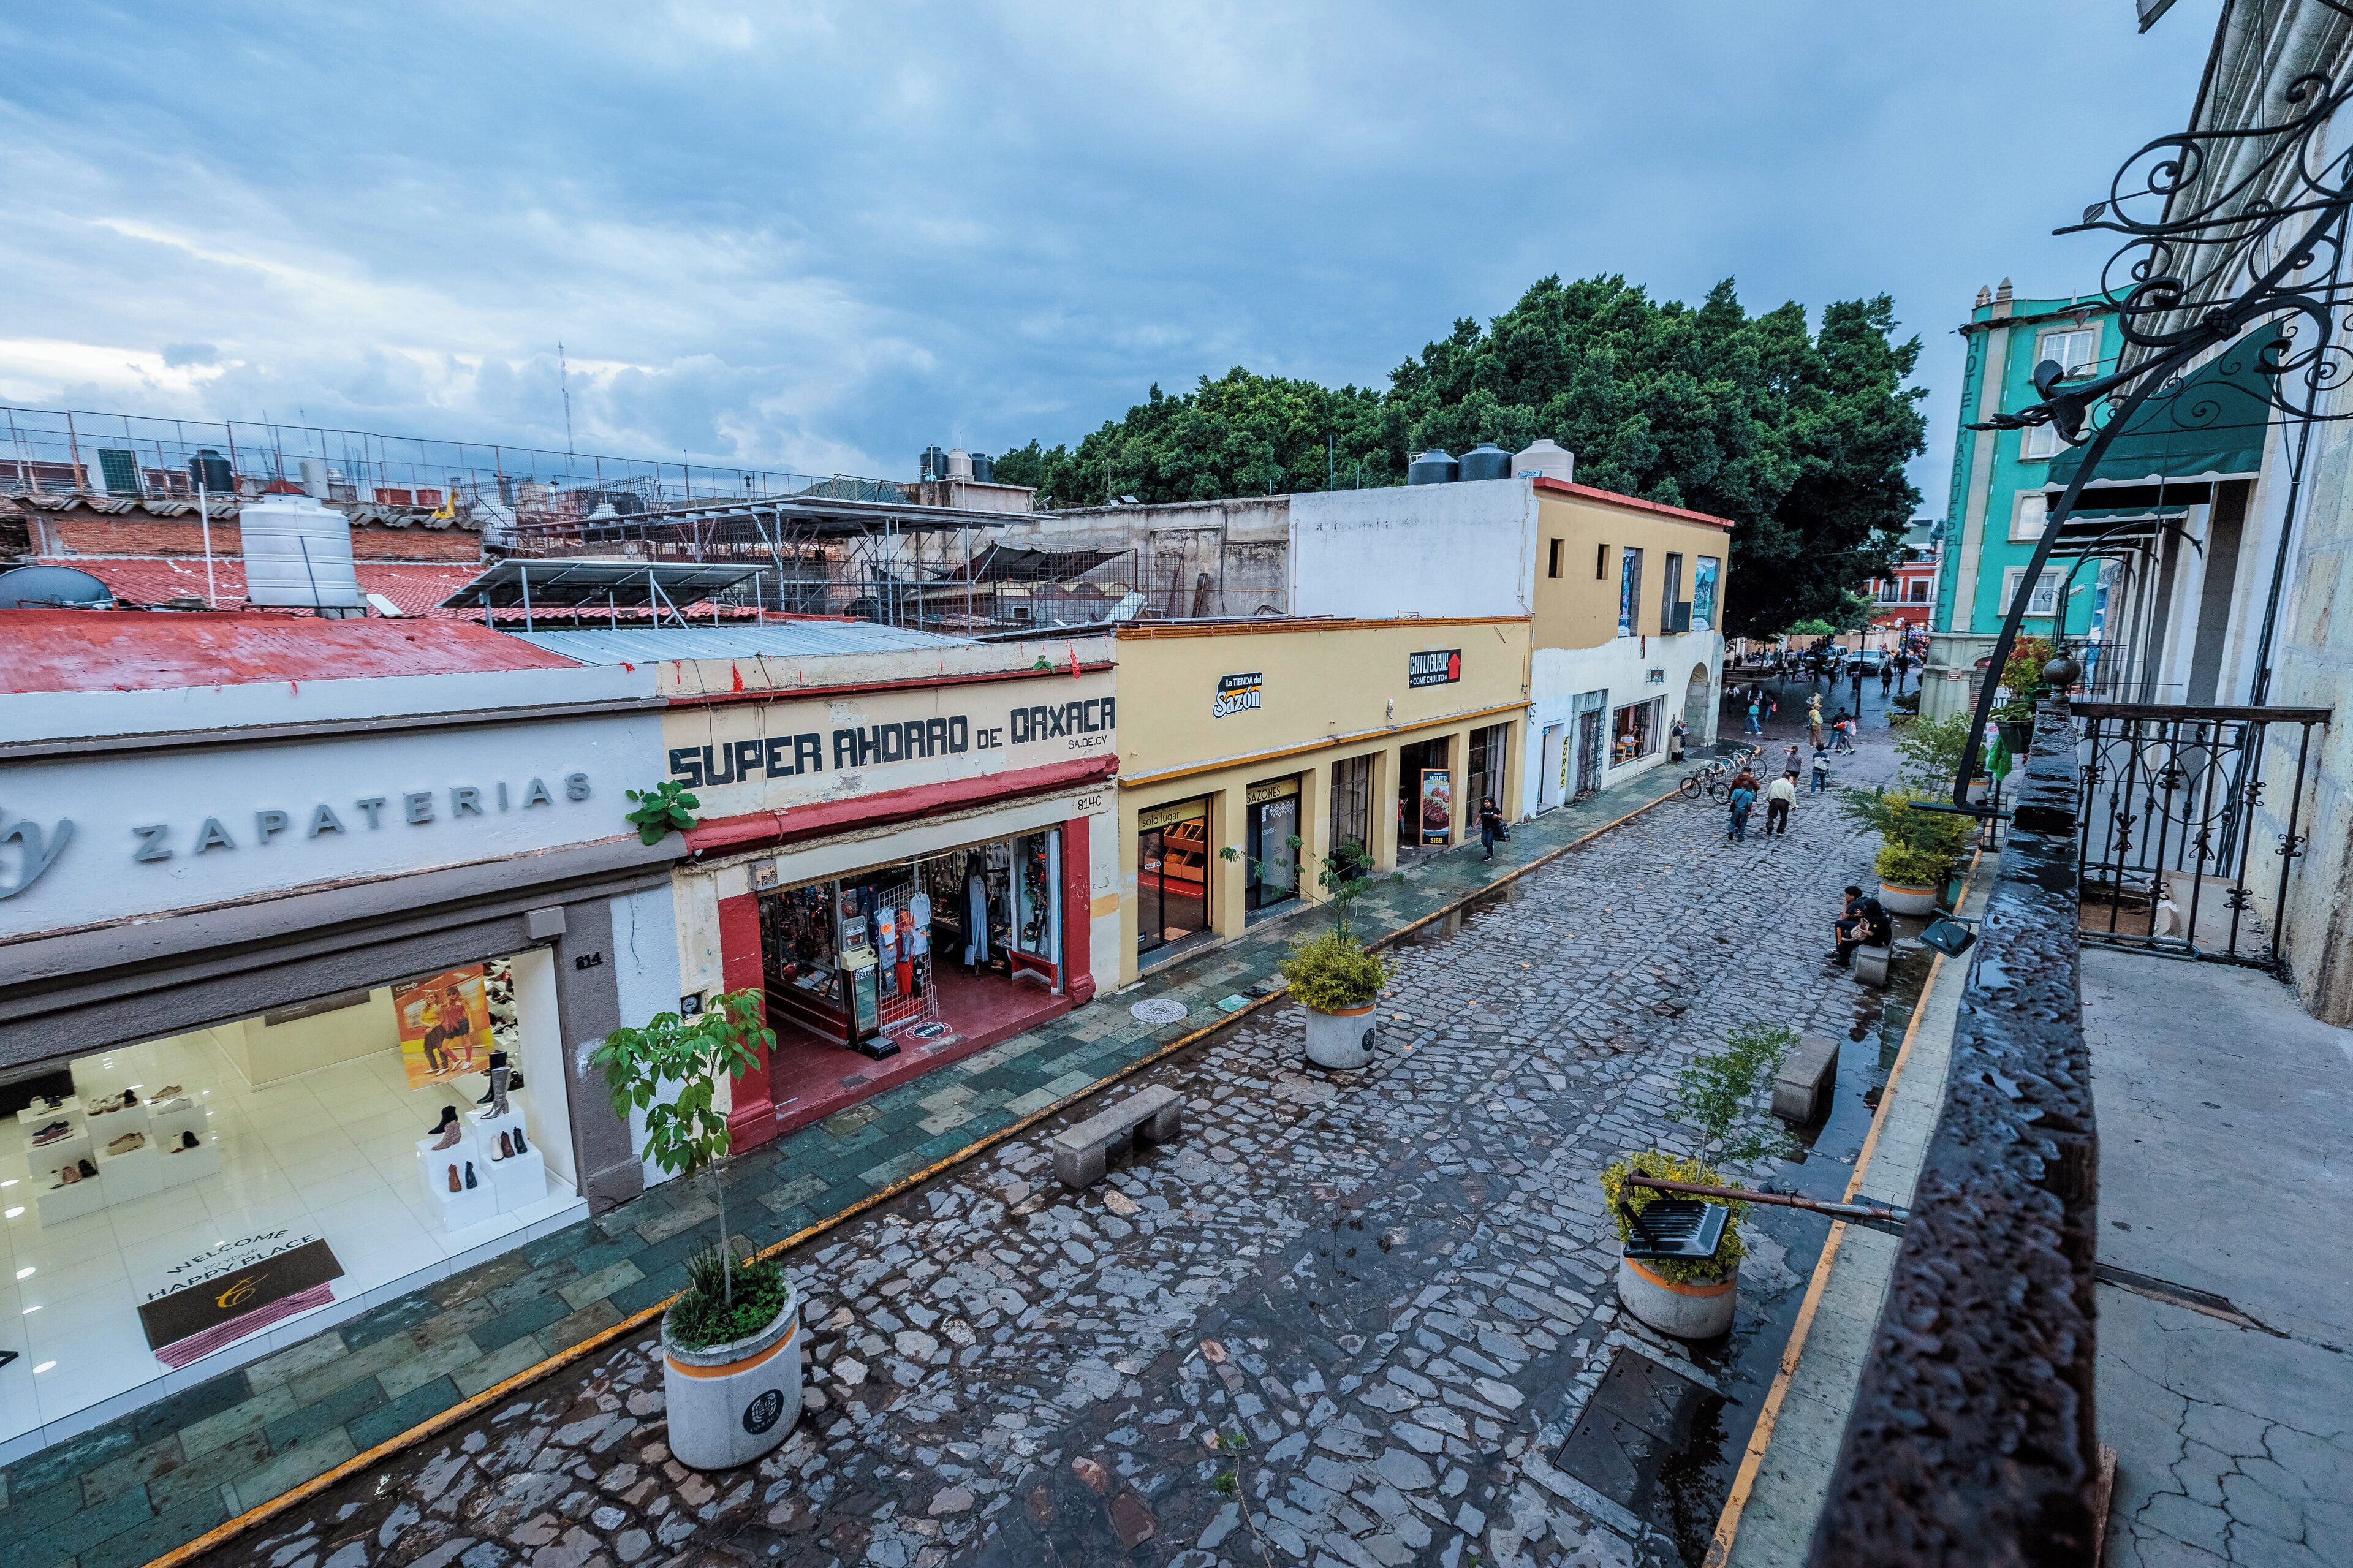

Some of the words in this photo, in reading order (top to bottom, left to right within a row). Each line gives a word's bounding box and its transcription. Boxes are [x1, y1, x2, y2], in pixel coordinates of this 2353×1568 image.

[1958, 334, 1981, 428] HOTEL
[1947, 428, 1968, 531] MARQUES
[1233, 676, 1253, 686] TIENDA
[1413, 676, 1426, 685] COME
[1426, 675, 1444, 683] CHULITO
[1213, 686, 1261, 718] Sazón
[669, 732, 823, 789] SUPER
[832, 714, 969, 770] AHORRO
[977, 727, 1003, 750] DE
[1010, 696, 1116, 744] OAXACA
[1560, 737, 1569, 788] EUROS
[1078, 795, 1101, 810] 814C
[1246, 786, 1281, 804] SAZONES
[132, 772, 591, 860] ZAPATERIAS
[1142, 816, 1159, 827] solo
[1161, 811, 1180, 824] lugar
[576, 951, 604, 970] 814
[396, 982, 418, 991] Candy
[166, 1229, 289, 1274] WELCOME
[223, 1248, 259, 1263] YOUR
[147, 1262, 235, 1300] HAPPY
[241, 1233, 316, 1266] PLACE
